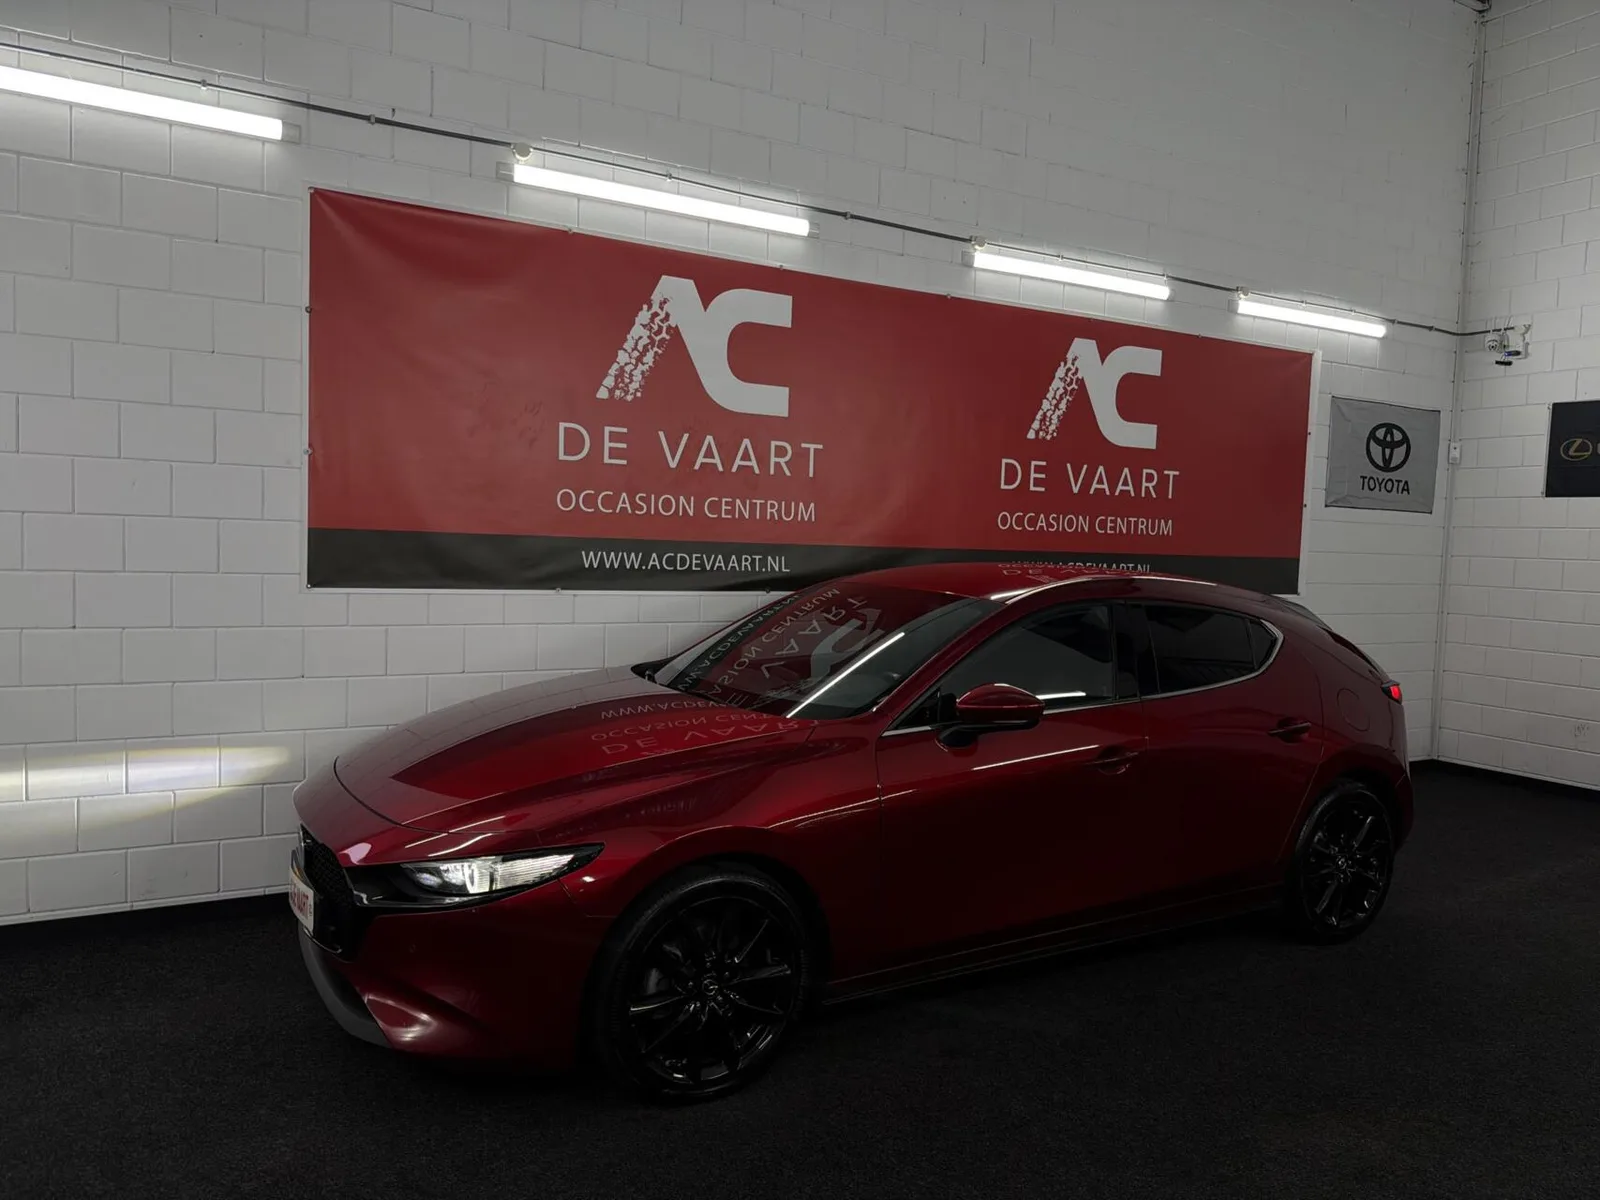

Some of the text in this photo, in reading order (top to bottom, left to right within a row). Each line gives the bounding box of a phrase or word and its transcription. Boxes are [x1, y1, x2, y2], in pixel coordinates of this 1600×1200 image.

[596, 275, 793, 418] AC
[1026, 337, 1163, 450] AC
[557, 422, 824, 478] DE VAART
[1000, 458, 1180, 499] DE VAART
[1359, 475, 1411, 496] TOYOTA
[556, 488, 816, 522] OCCASION CENTRUM
[997, 511, 1173, 536] OCCASION CENTRUM
[581, 550, 791, 573] WWW.ACDEVAART.NL
